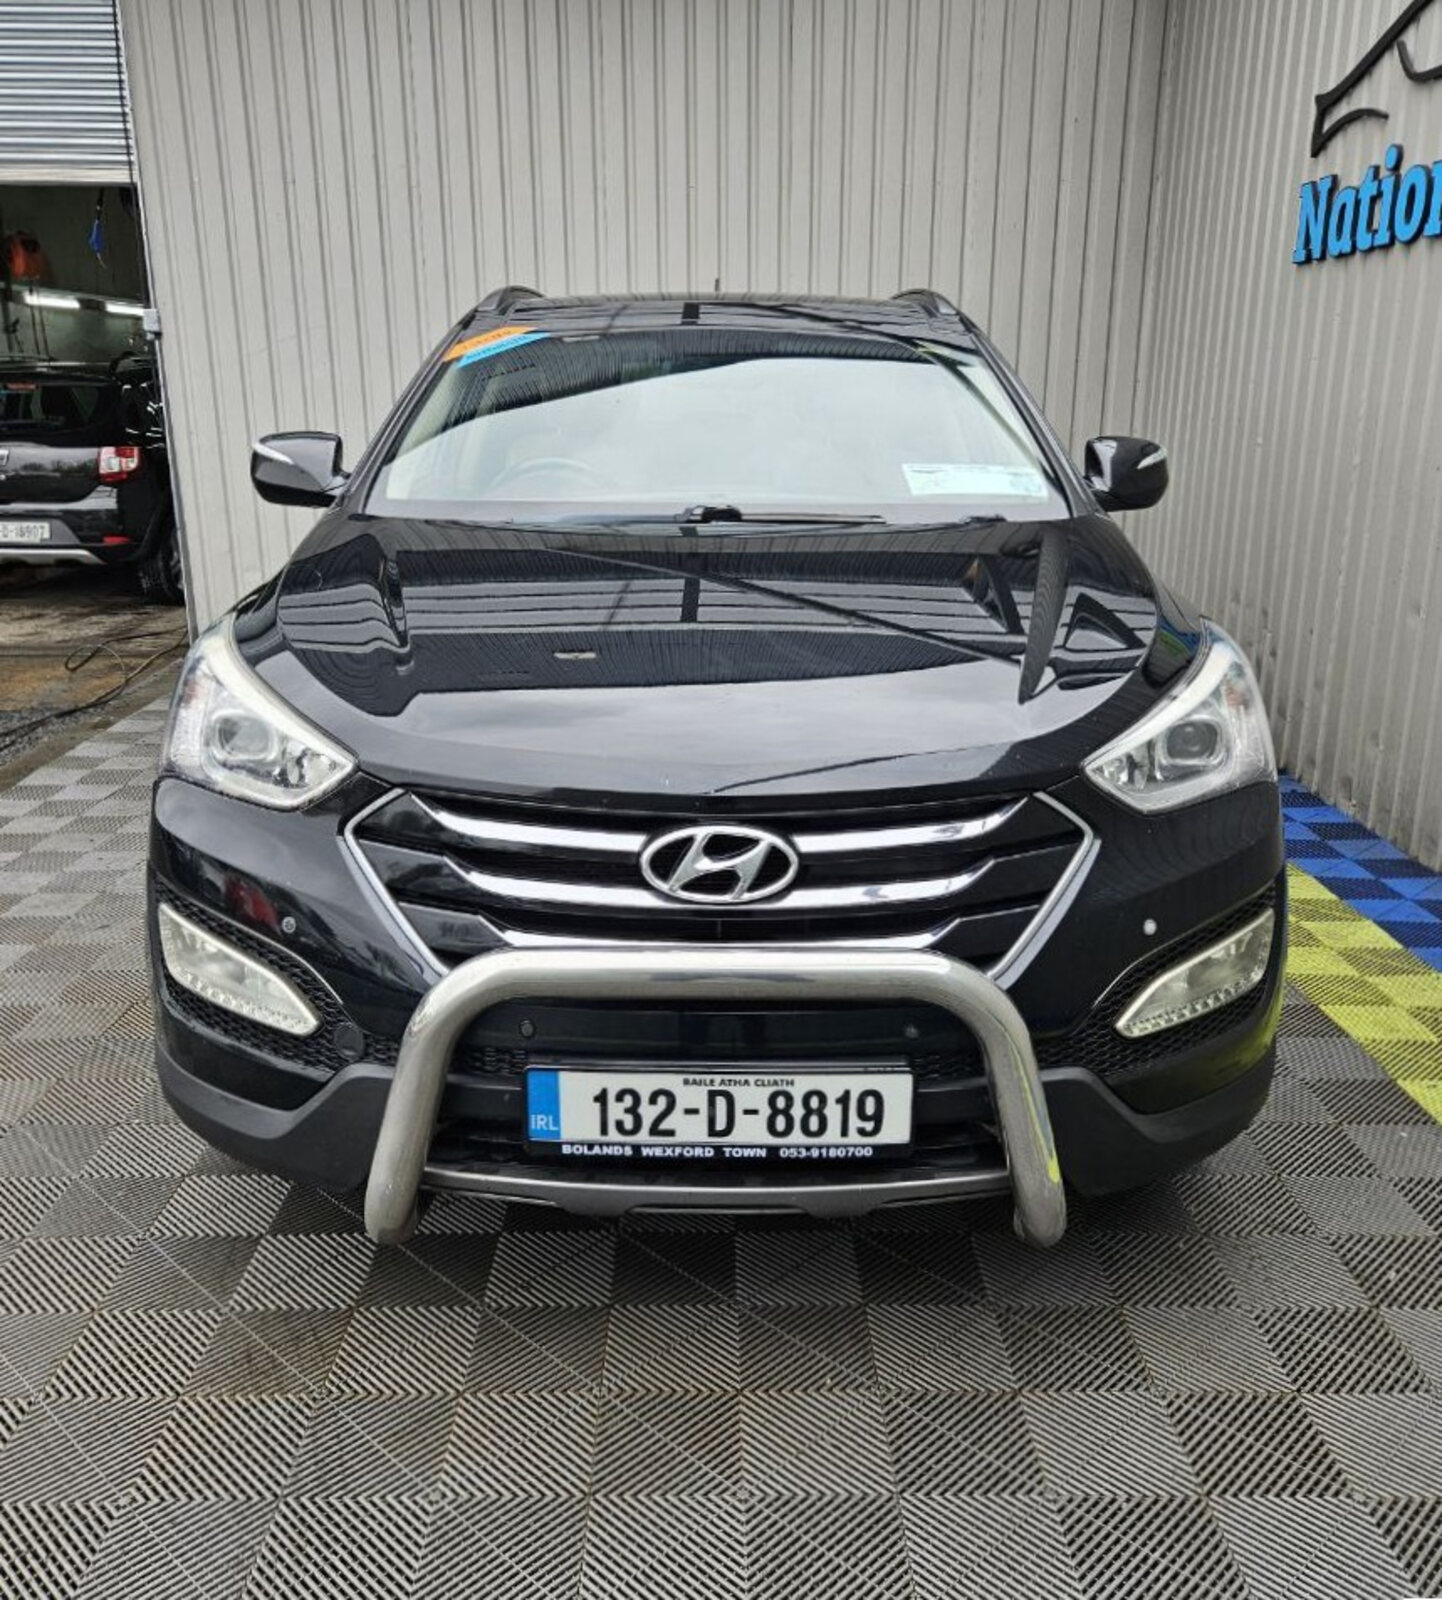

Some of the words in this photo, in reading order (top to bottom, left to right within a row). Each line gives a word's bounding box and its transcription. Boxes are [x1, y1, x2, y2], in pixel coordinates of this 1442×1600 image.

[683, 1077, 715, 1087] BAILE
[718, 1078, 751, 1087] ATHA
[754, 1078, 795, 1087] CLIATH
[593, 1087, 885, 1138] 132-D-8819
[531, 1114, 559, 1131] IRL
[561, 1144, 633, 1156] BOLANDS
[641, 1146, 715, 1158] WEXFORD
[723, 1147, 767, 1158] TOWN
[779, 1146, 873, 1158] 053-9180700
